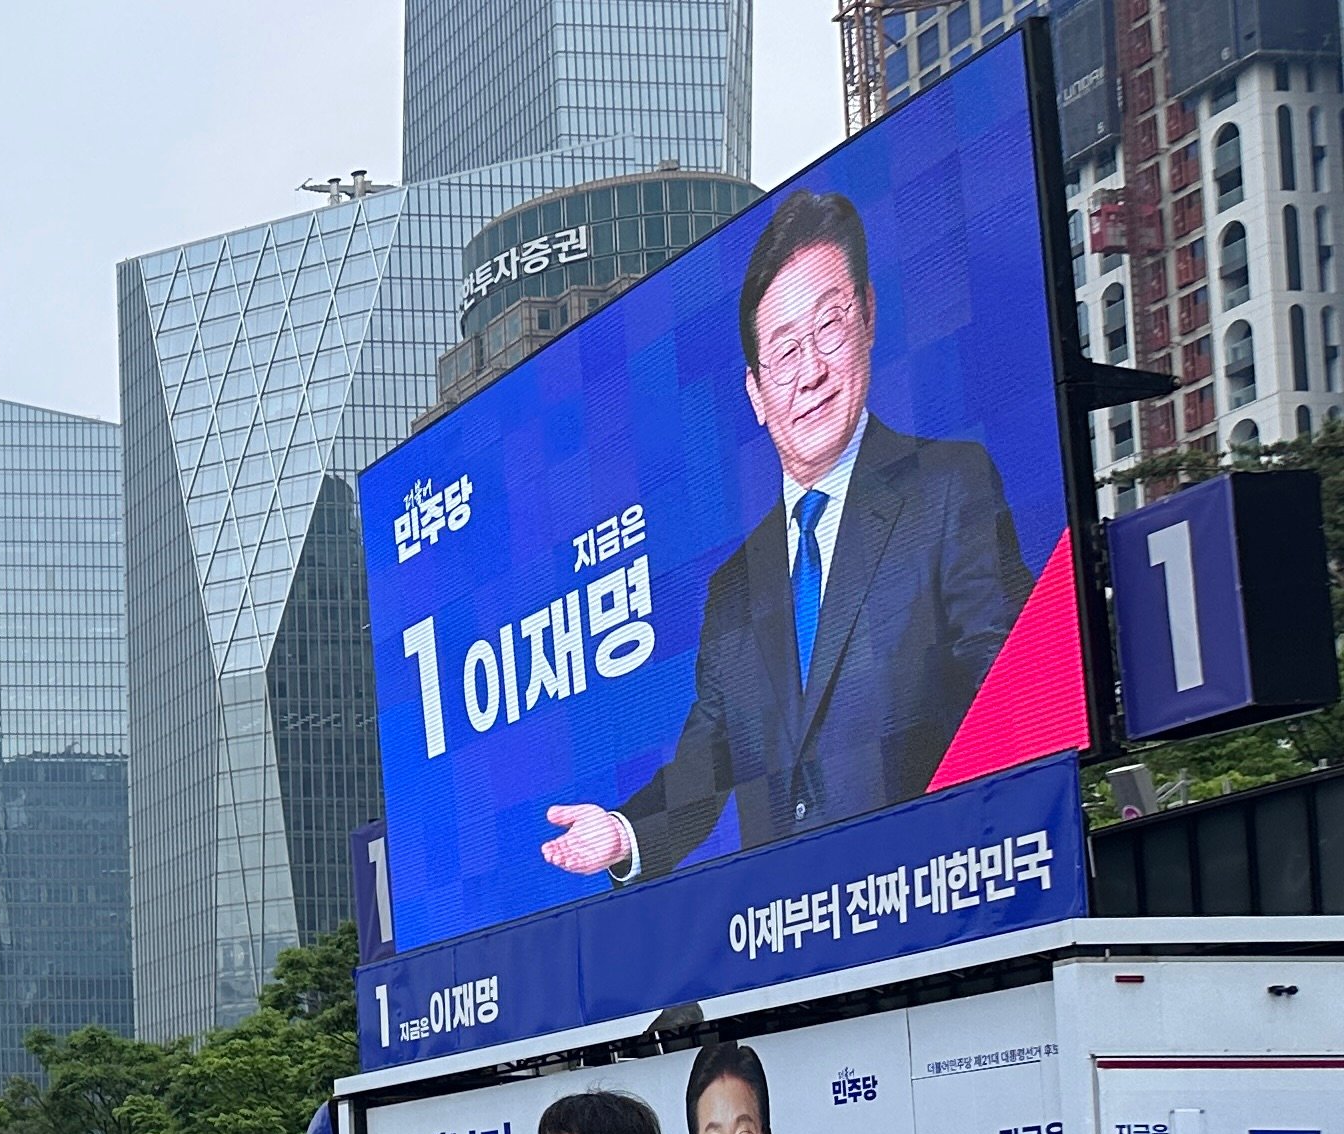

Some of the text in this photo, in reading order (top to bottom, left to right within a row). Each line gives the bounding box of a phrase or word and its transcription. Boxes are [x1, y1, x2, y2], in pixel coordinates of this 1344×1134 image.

[460, 225, 588, 312] 한투자증권
[394, 473, 473, 564] 민주당
[573, 504, 646, 573] 지금은
[1147, 520, 1205, 692] 1
[402, 554, 656, 760] 1 이재명
[368, 837, 393, 943] 1
[729, 830, 1054, 960] 이제부터 진짜 대한민국
[375, 975, 499, 1048] 1 지금은 이재명
[832, 1075, 878, 1105] 민주당
[927, 1056, 972, 1074] 더불어민주당
[973, 1051, 1000, 1068] 제21대
[1000, 1045, 1042, 1063] 대통령선거
